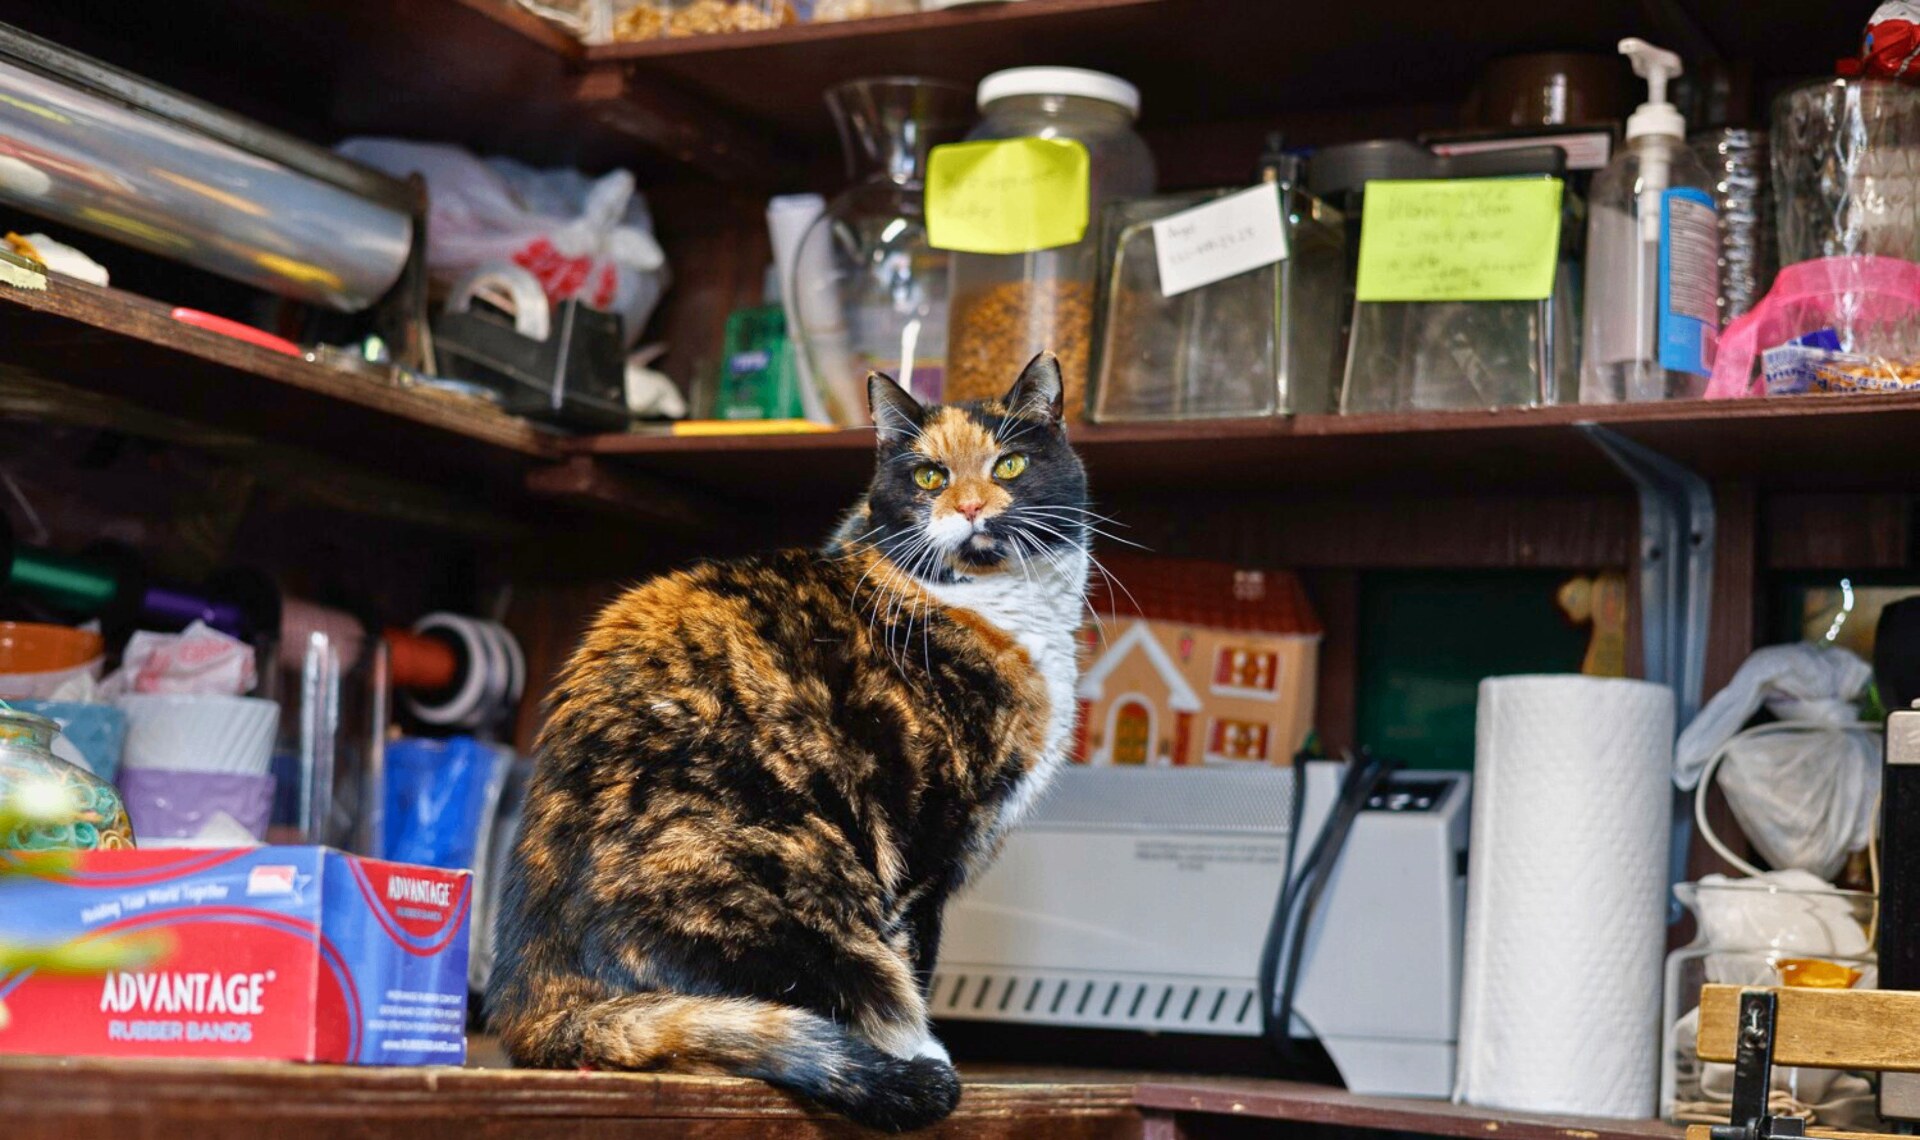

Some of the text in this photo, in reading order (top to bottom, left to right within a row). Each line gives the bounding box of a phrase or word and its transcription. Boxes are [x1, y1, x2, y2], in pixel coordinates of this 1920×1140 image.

[387, 875, 450, 907] ADVANTAGE
[100, 971, 265, 1015] ADVANTAGE
[108, 1020, 252, 1042] RUBBER BANDS
